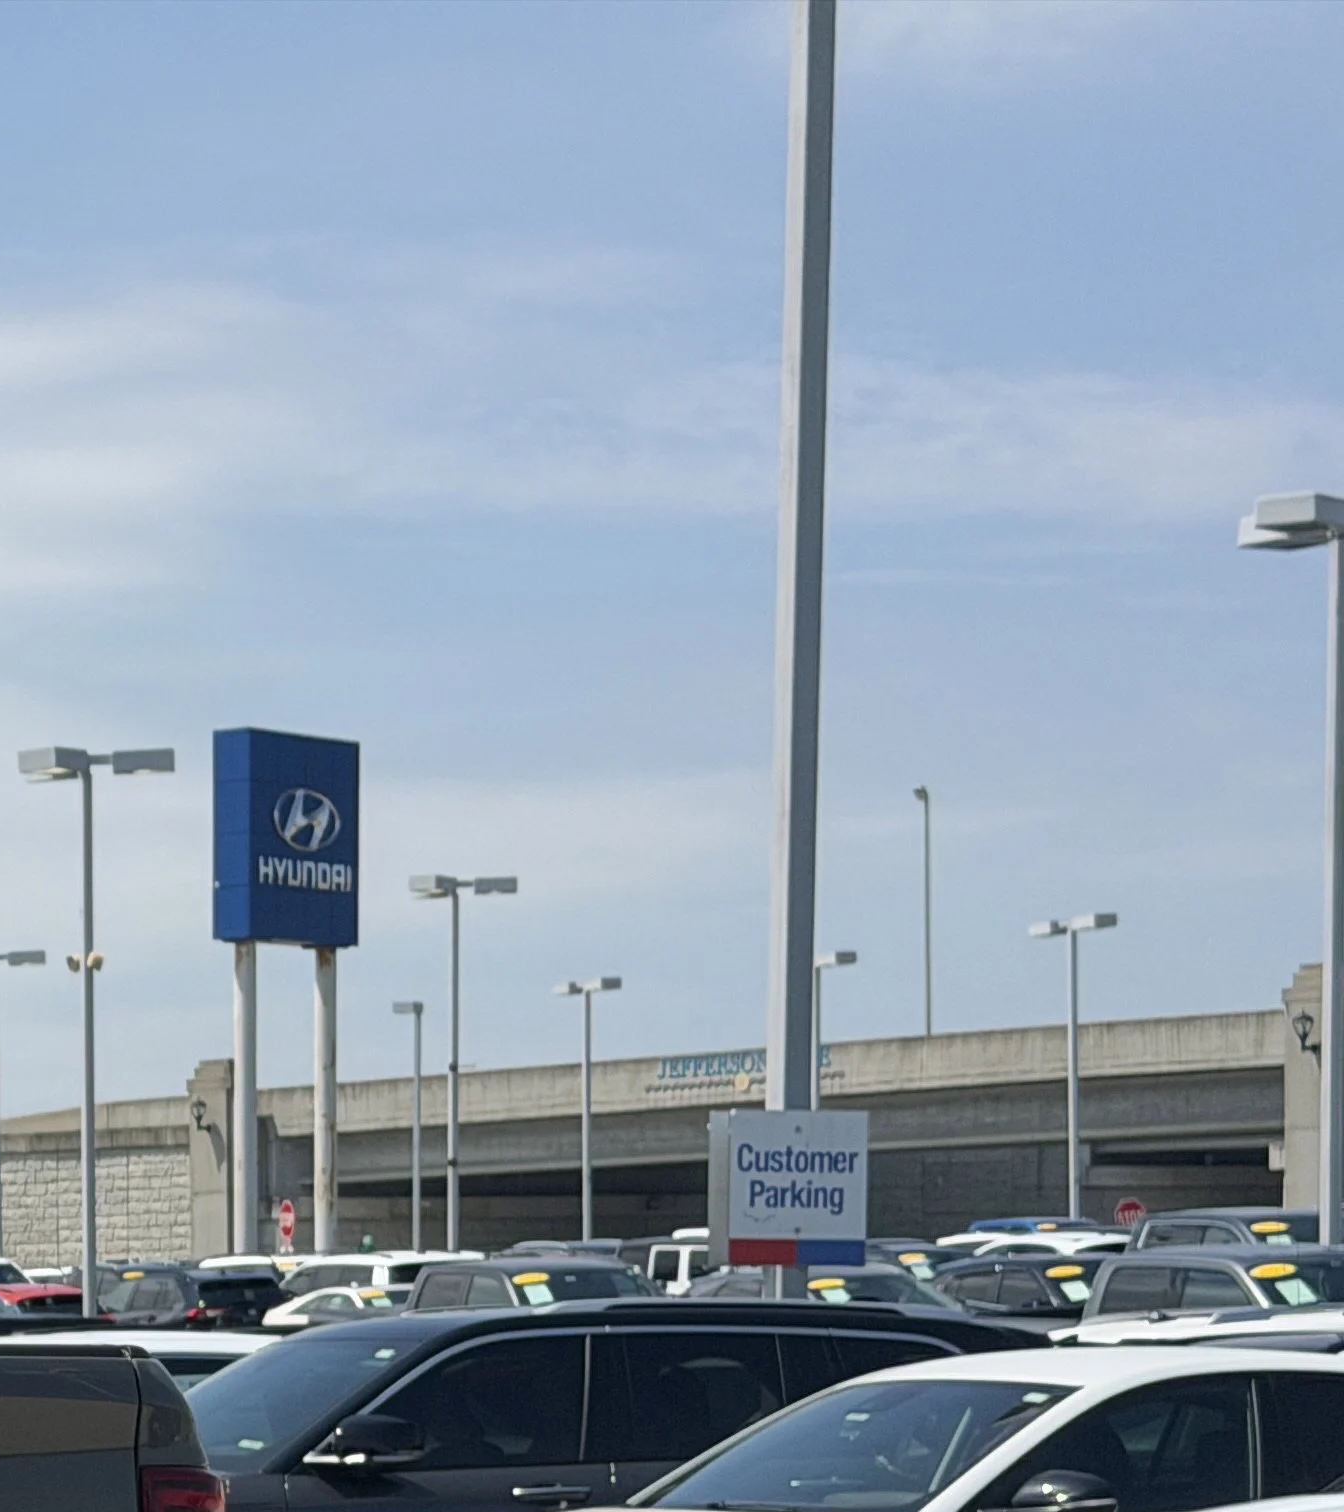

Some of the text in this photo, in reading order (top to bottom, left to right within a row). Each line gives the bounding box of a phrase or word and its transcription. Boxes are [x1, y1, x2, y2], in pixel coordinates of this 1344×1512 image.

[259, 856, 353, 892] HYUNDAI
[736, 1143, 858, 1173] Customer
[749, 1179, 845, 1216] Parking
